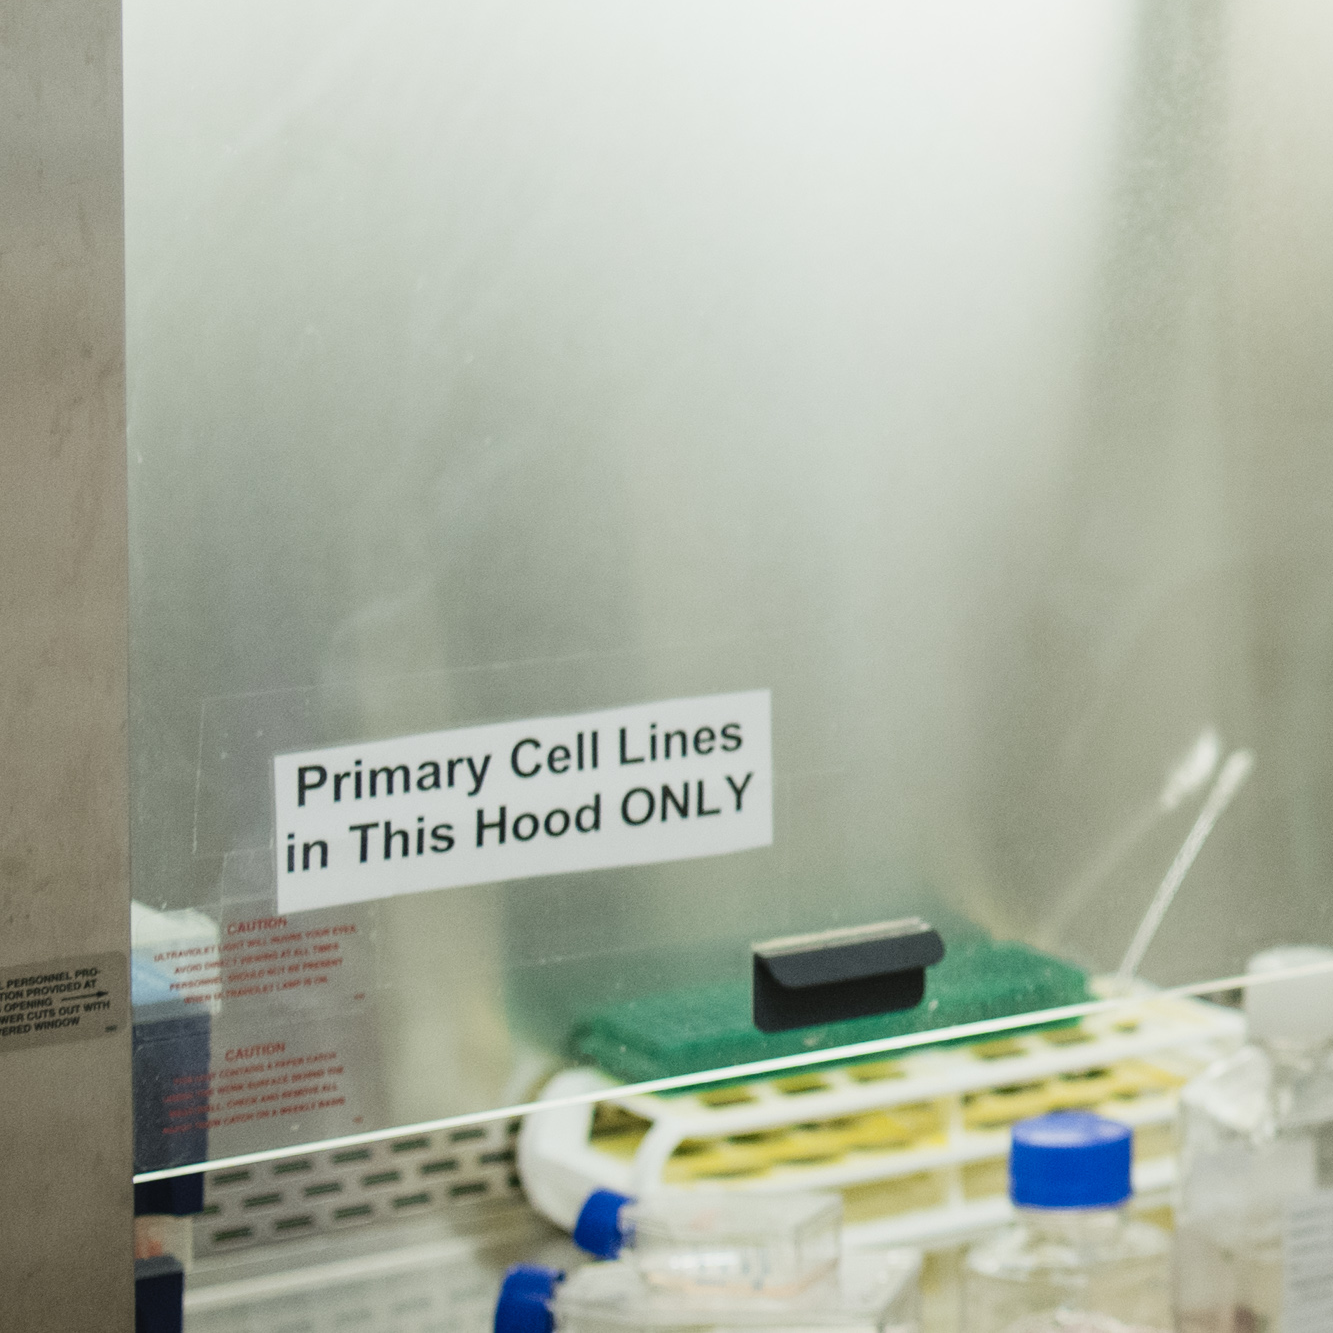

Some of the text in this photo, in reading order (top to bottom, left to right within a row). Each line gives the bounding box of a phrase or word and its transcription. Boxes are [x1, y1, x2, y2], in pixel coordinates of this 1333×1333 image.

[296, 722, 741, 805] Primary Cell Lines
[285, 773, 750, 872] in This Hood ONLY
[227, 914, 287, 934] CAUTION
[6, 971, 70, 988] PERSONNEL
[74, 966, 99, 978] PRO-
[26, 981, 82, 997] PROVIDED
[4, 997, 53, 1011] OPENING
[26, 1008, 55, 1020] CUTS
[58, 1004, 80, 1015] OUT
[83, 1000, 110, 1011] WITH
[34, 1016, 80, 1031] WINDOW
[224, 1040, 286, 1061] CAUTION
